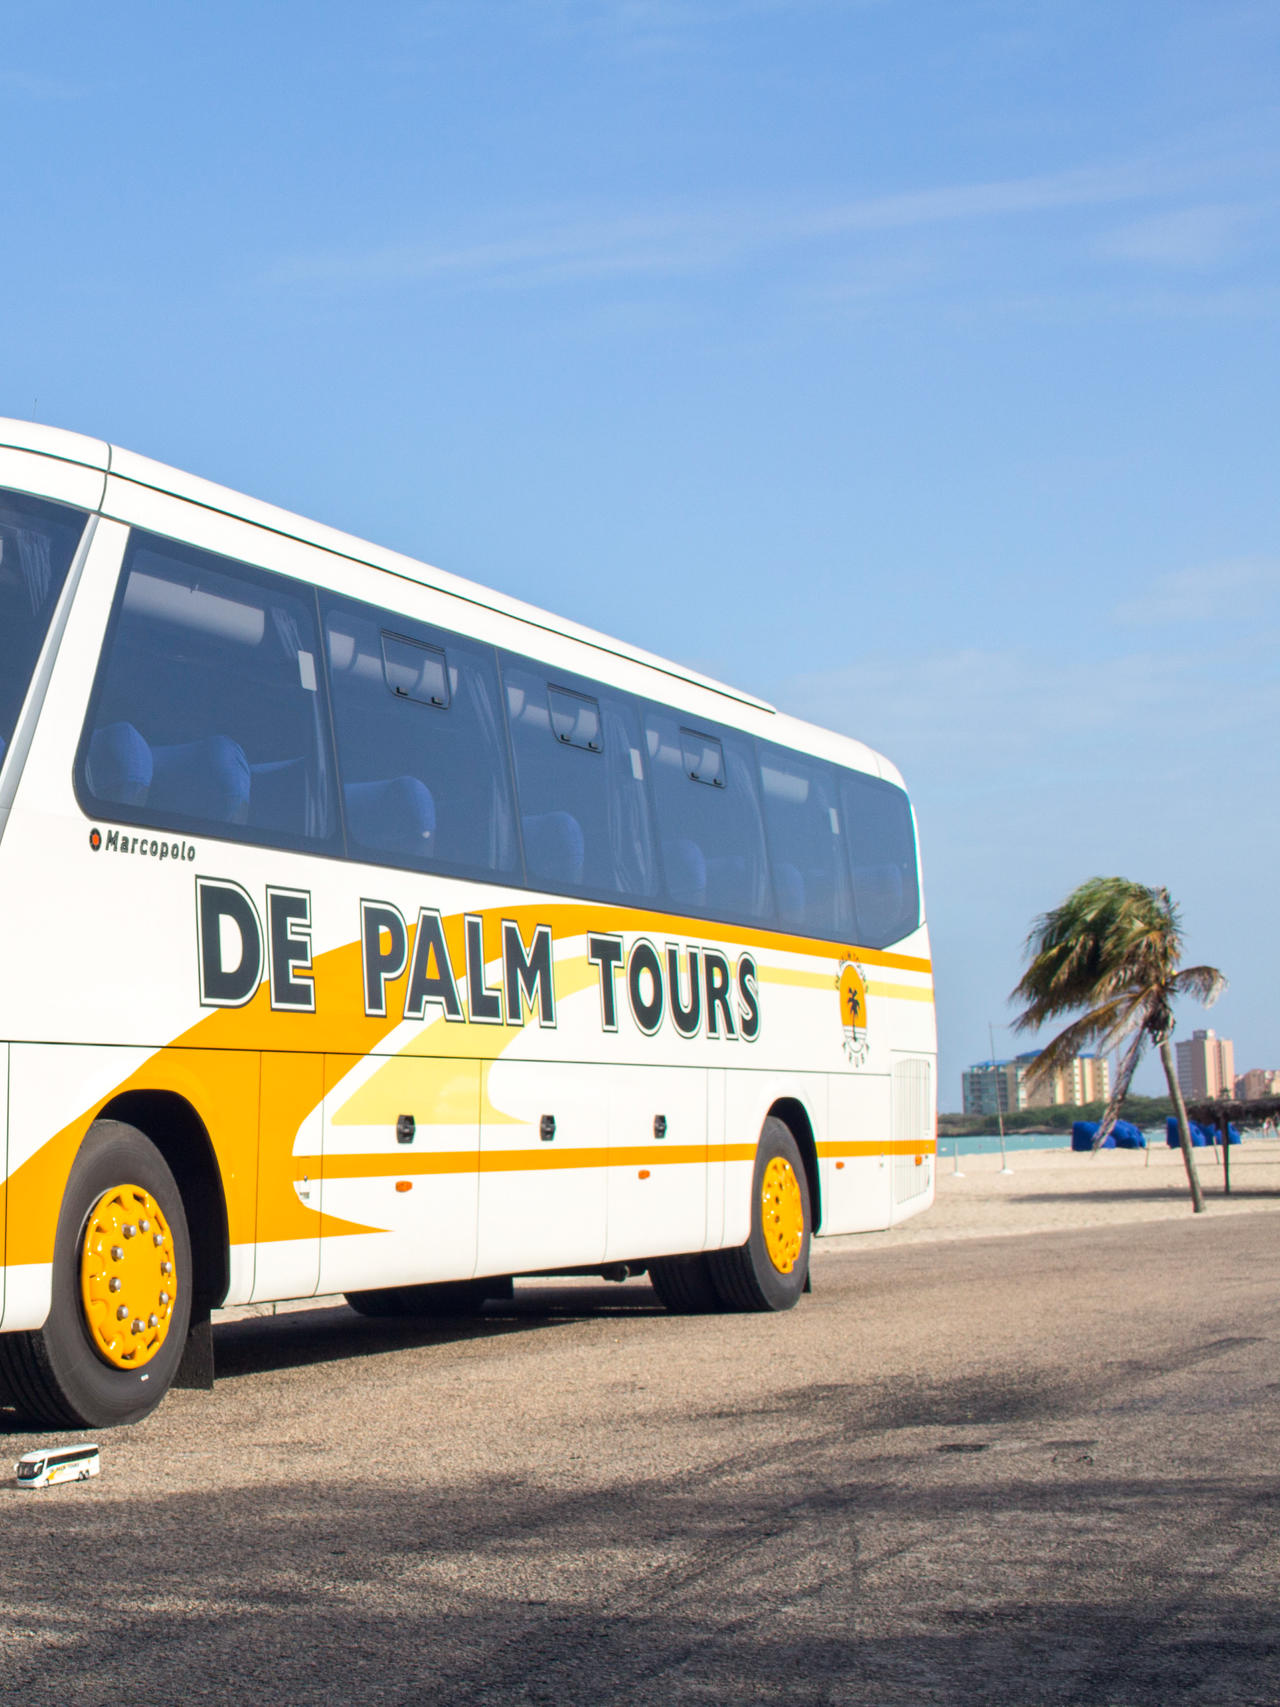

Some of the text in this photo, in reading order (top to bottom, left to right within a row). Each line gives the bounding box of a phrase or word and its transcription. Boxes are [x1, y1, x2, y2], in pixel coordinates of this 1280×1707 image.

[105, 829, 196, 862] Marcopolo
[195, 874, 762, 1044] DE PALM TOURS
